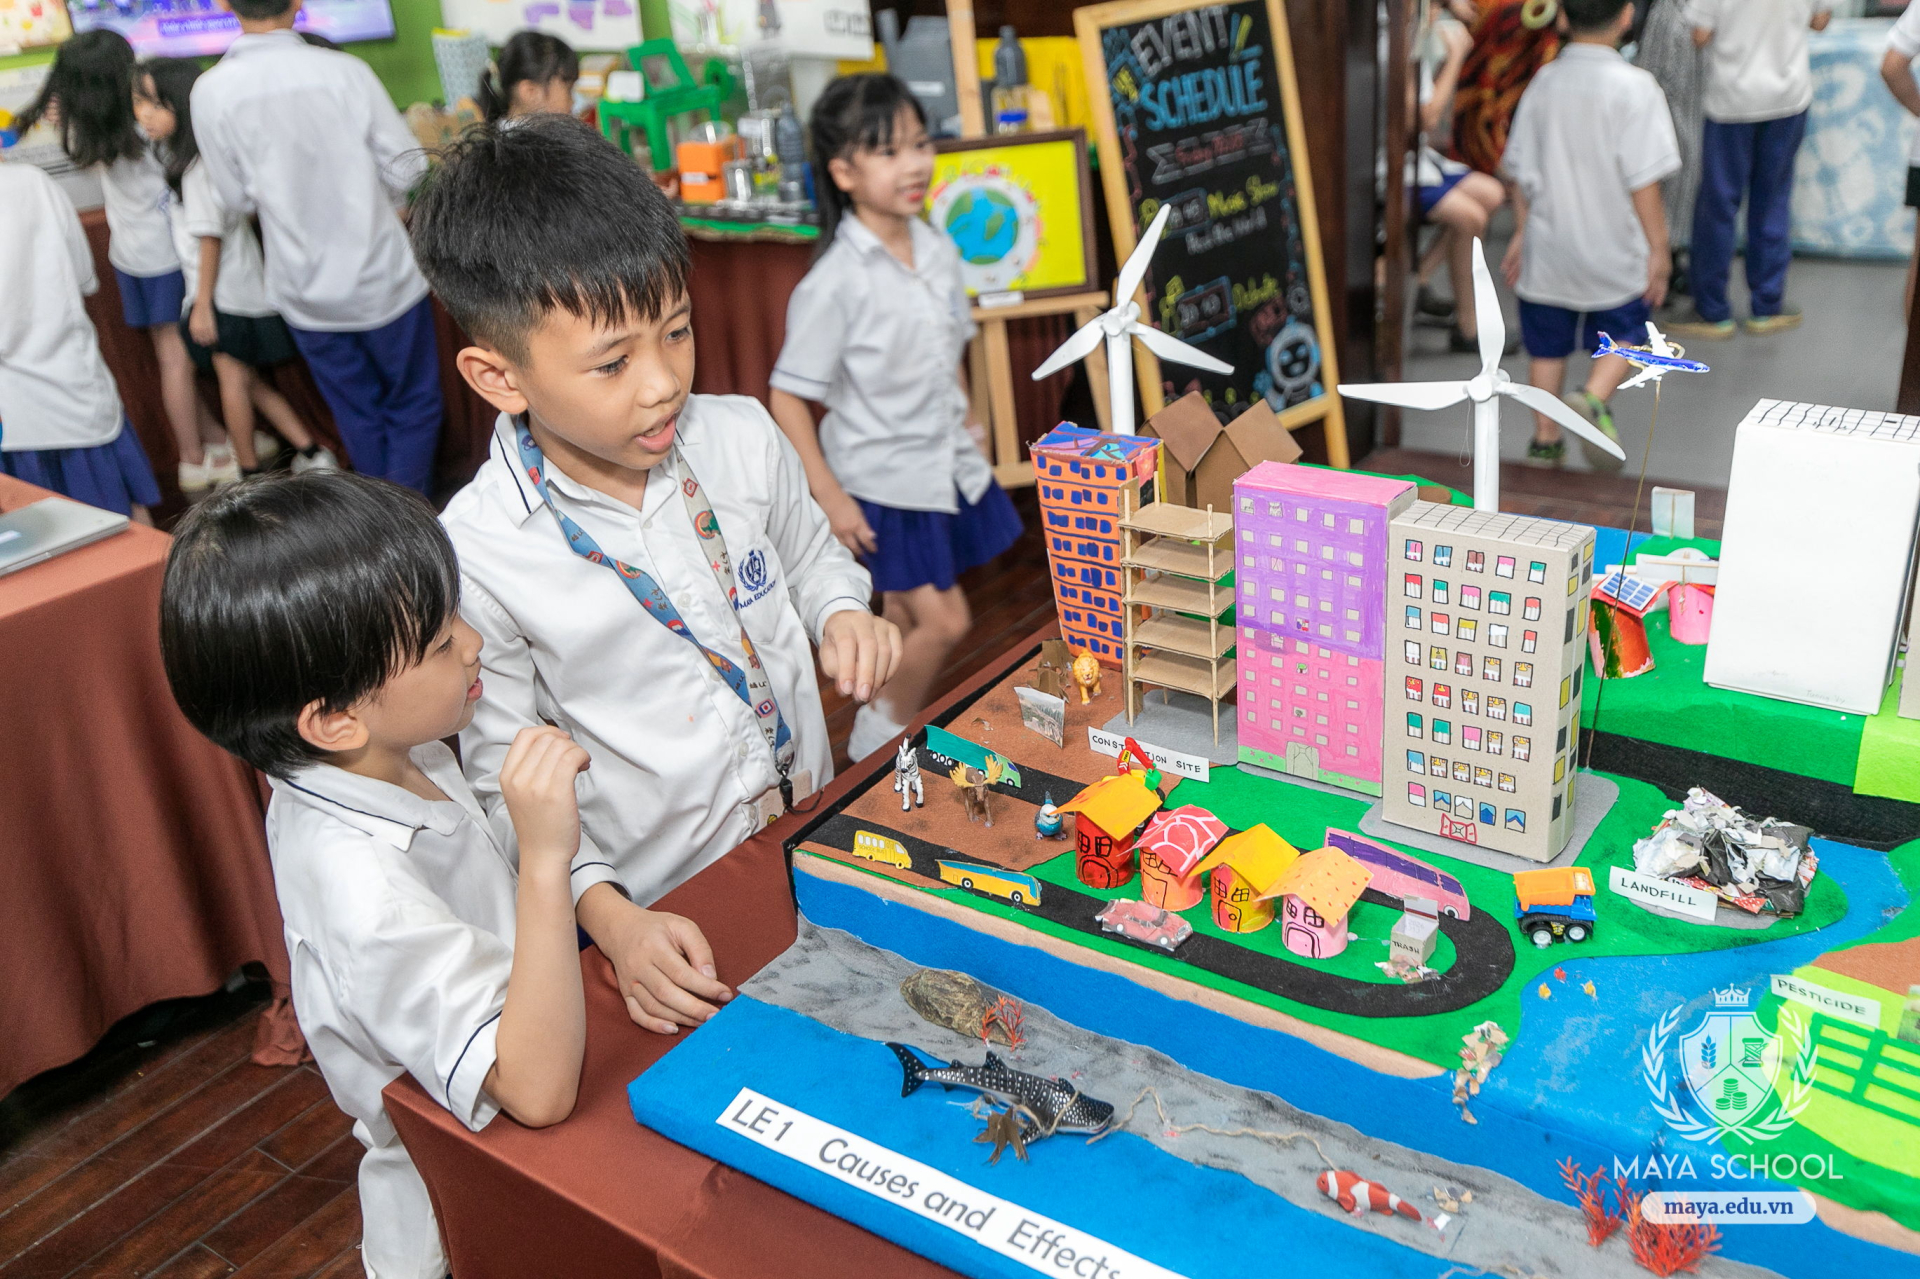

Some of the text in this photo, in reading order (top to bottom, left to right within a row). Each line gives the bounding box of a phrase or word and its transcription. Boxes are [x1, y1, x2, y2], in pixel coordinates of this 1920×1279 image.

[1130, 5, 1229, 76] EVENT
[1139, 60, 1268, 131] SCHEDULE
[1092, 735, 1167, 764] CONSTTION
[1176, 760, 1201, 773] SITE
[1621, 877, 1697, 906] LANDFILL
[1392, 940, 1420, 954] TRASH
[1777, 979, 1866, 1015] PESTICIDE
[818, 1138, 919, 1199] Causes
[923, 1190, 996, 1232] and
